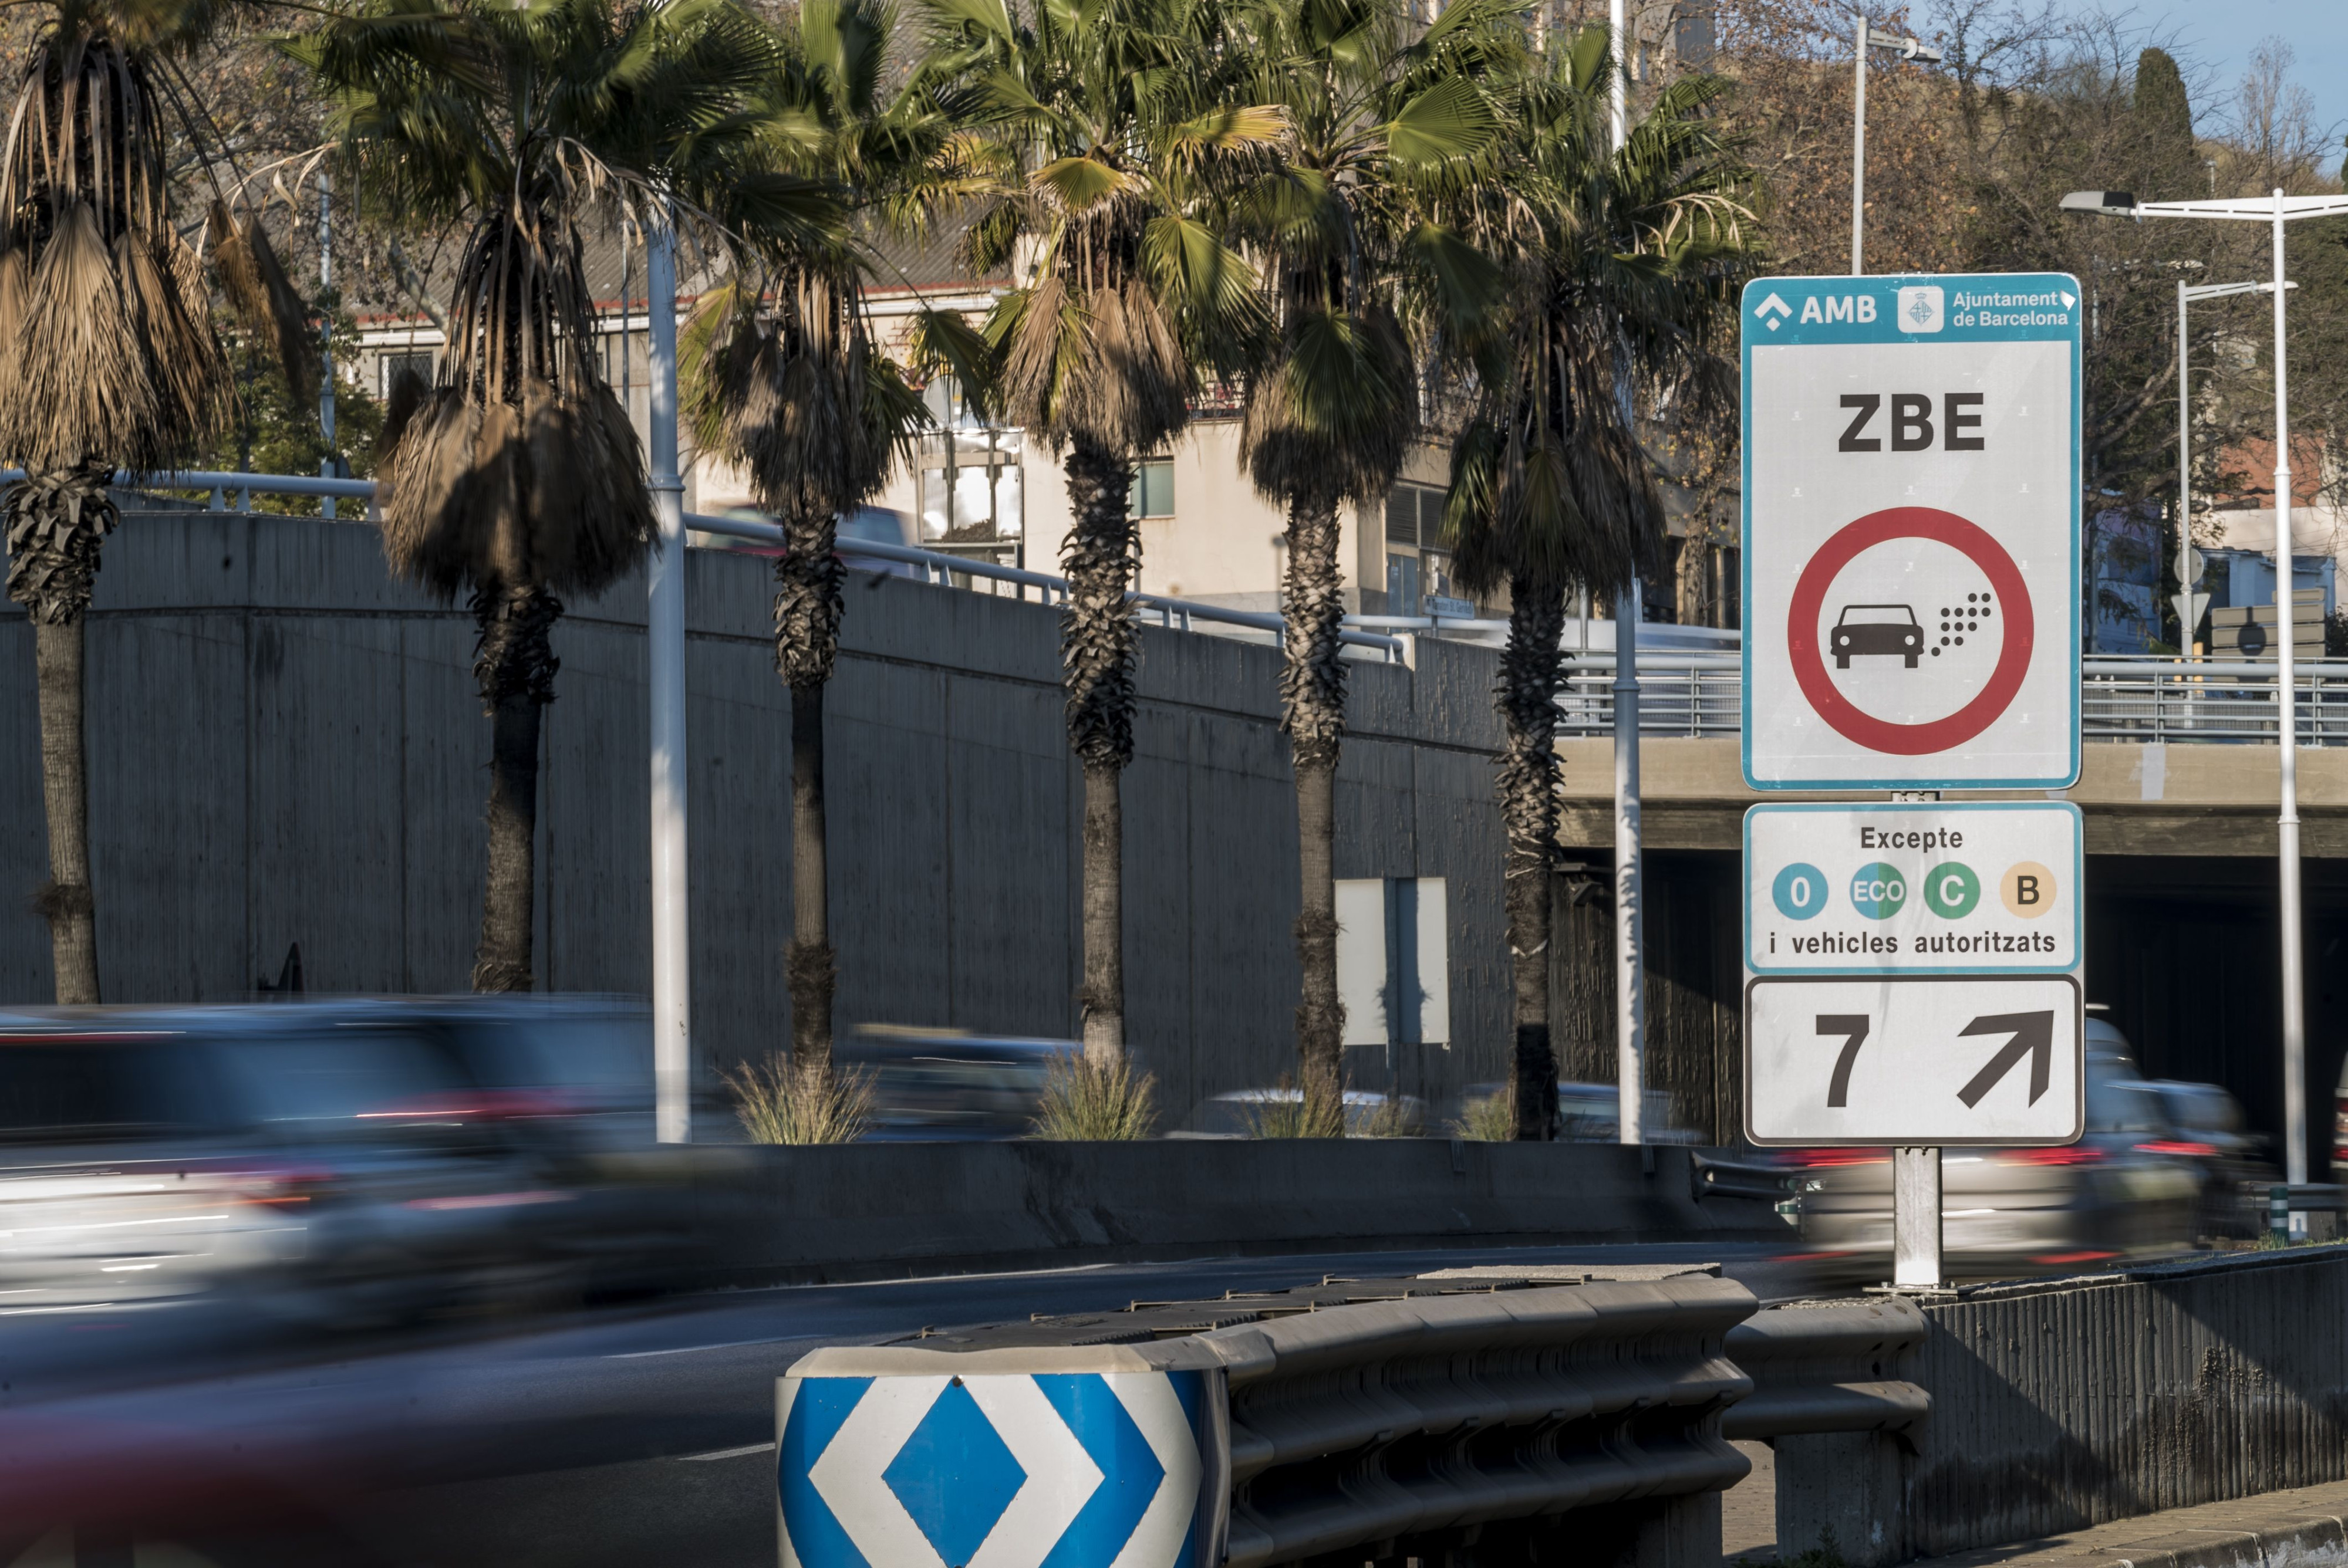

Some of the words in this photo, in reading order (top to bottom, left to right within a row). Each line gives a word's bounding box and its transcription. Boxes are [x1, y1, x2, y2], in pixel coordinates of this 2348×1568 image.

[1800, 295, 1877, 324] AMB
[1953, 291, 2058, 311] Ajuntament
[1953, 310, 1975, 327] de
[1979, 309, 2069, 326] Barcelona
[1838, 392, 1985, 452] ZBE
[1861, 826, 1963, 853] Excepte
[1854, 880, 1904, 902] ECO
[1939, 874, 1965, 907] C
[2018, 875, 2040, 905] B
[1770, 932, 1776, 954] i
[1792, 931, 1898, 954] vehicles
[1915, 931, 2055, 953] autoritzats
[1816, 1014, 1870, 1108] 7
